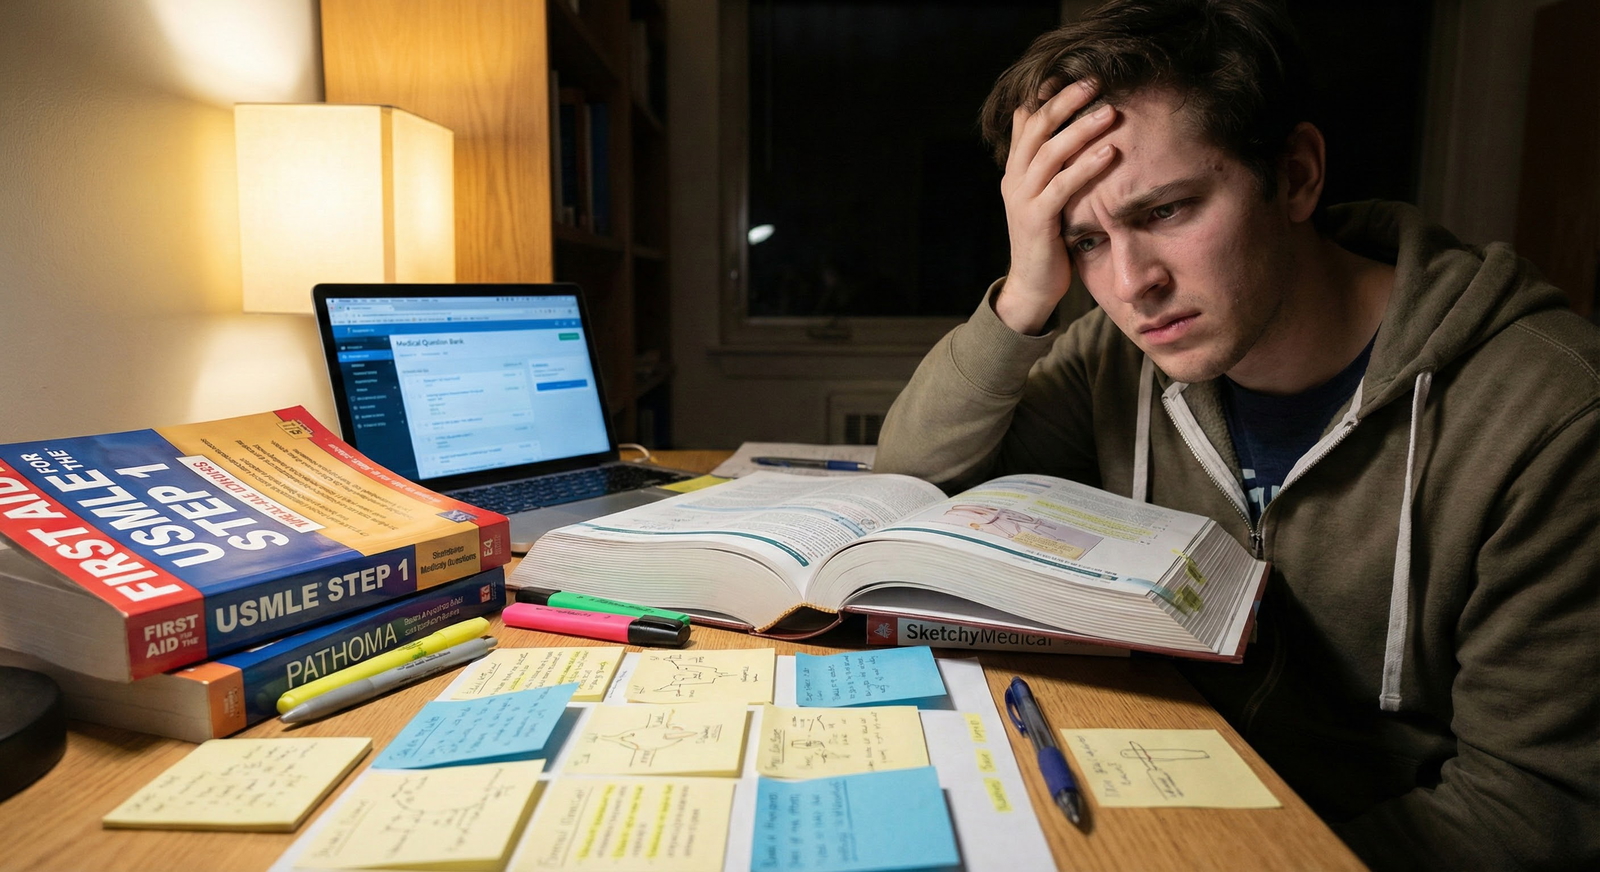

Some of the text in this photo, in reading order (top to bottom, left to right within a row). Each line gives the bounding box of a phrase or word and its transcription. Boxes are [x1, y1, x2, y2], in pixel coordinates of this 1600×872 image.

[396, 339, 421, 347] Medical
[20, 453, 59, 474] FOR
[114, 463, 170, 479] 1
[43, 469, 226, 568] USMLE
[146, 485, 290, 551] STEP
[28, 527, 182, 602] FIRST
[215, 558, 409, 633] USMLE STEP 1
[144, 613, 199, 642] FIRST
[146, 637, 179, 659] AID
[286, 622, 398, 689] PATHOMA
